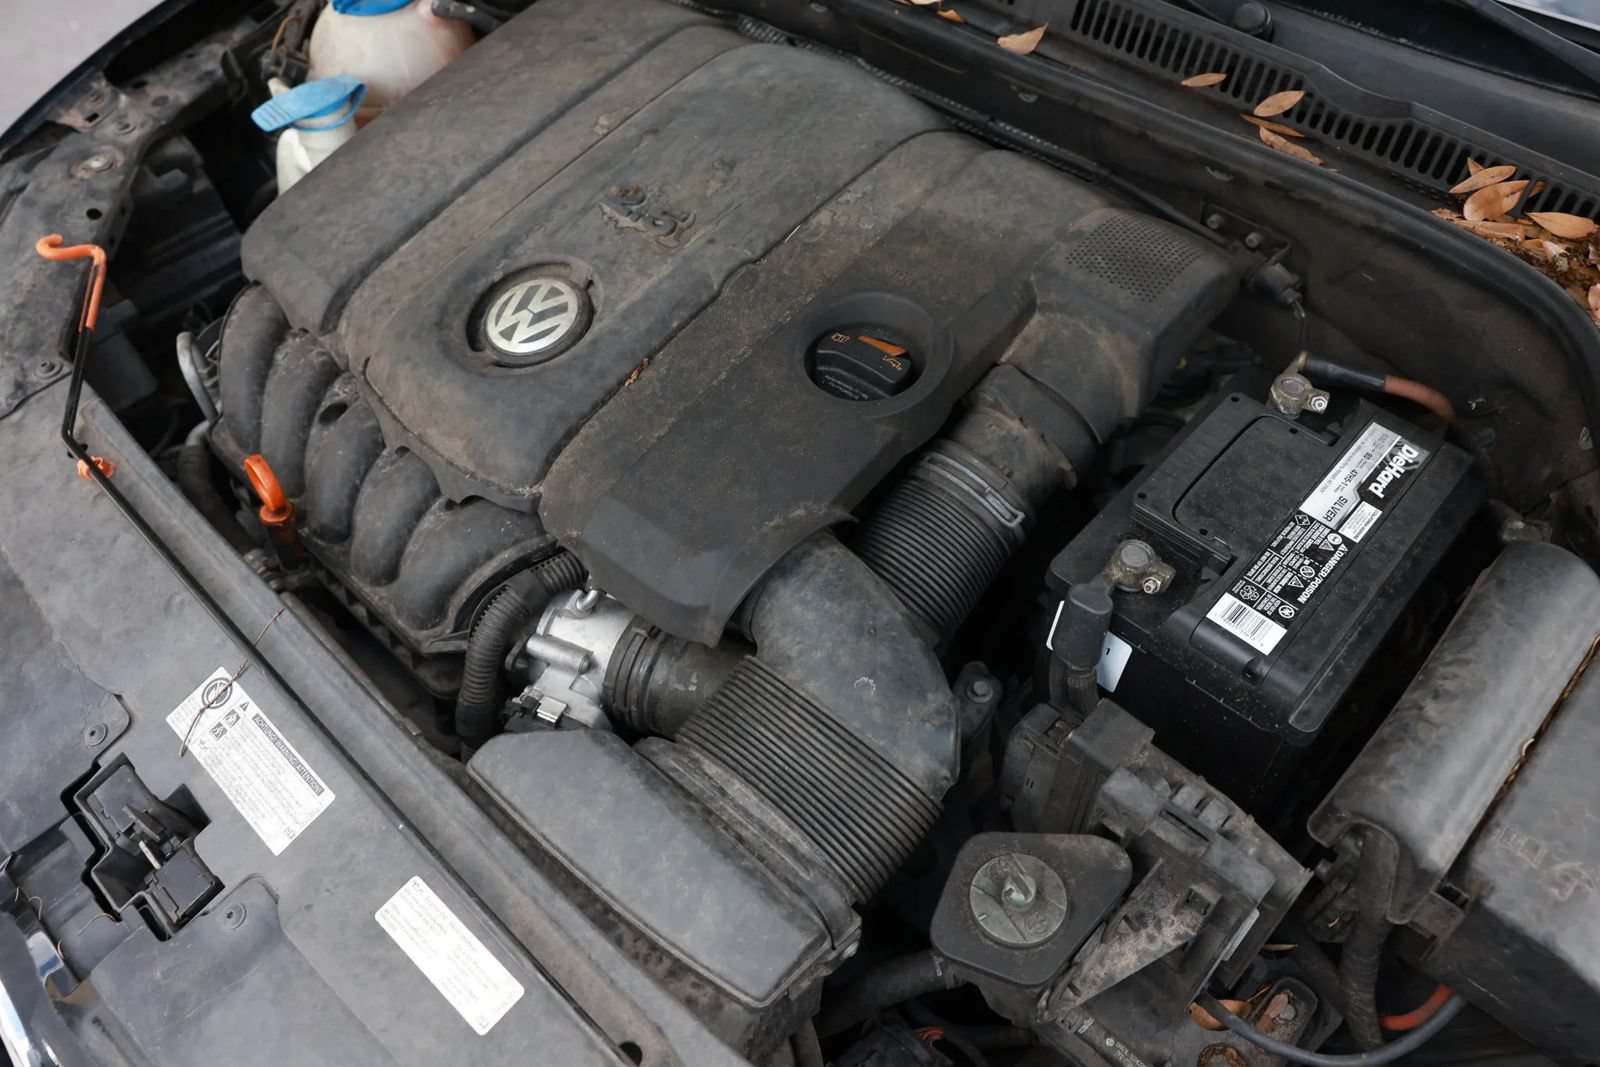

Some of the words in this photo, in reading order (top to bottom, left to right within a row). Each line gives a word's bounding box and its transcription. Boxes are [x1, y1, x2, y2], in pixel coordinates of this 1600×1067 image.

[1366, 443, 1420, 499] DieHard
[1322, 495, 1349, 522] SILVER
[1296, 549, 1344, 604] DANGER/POISON
